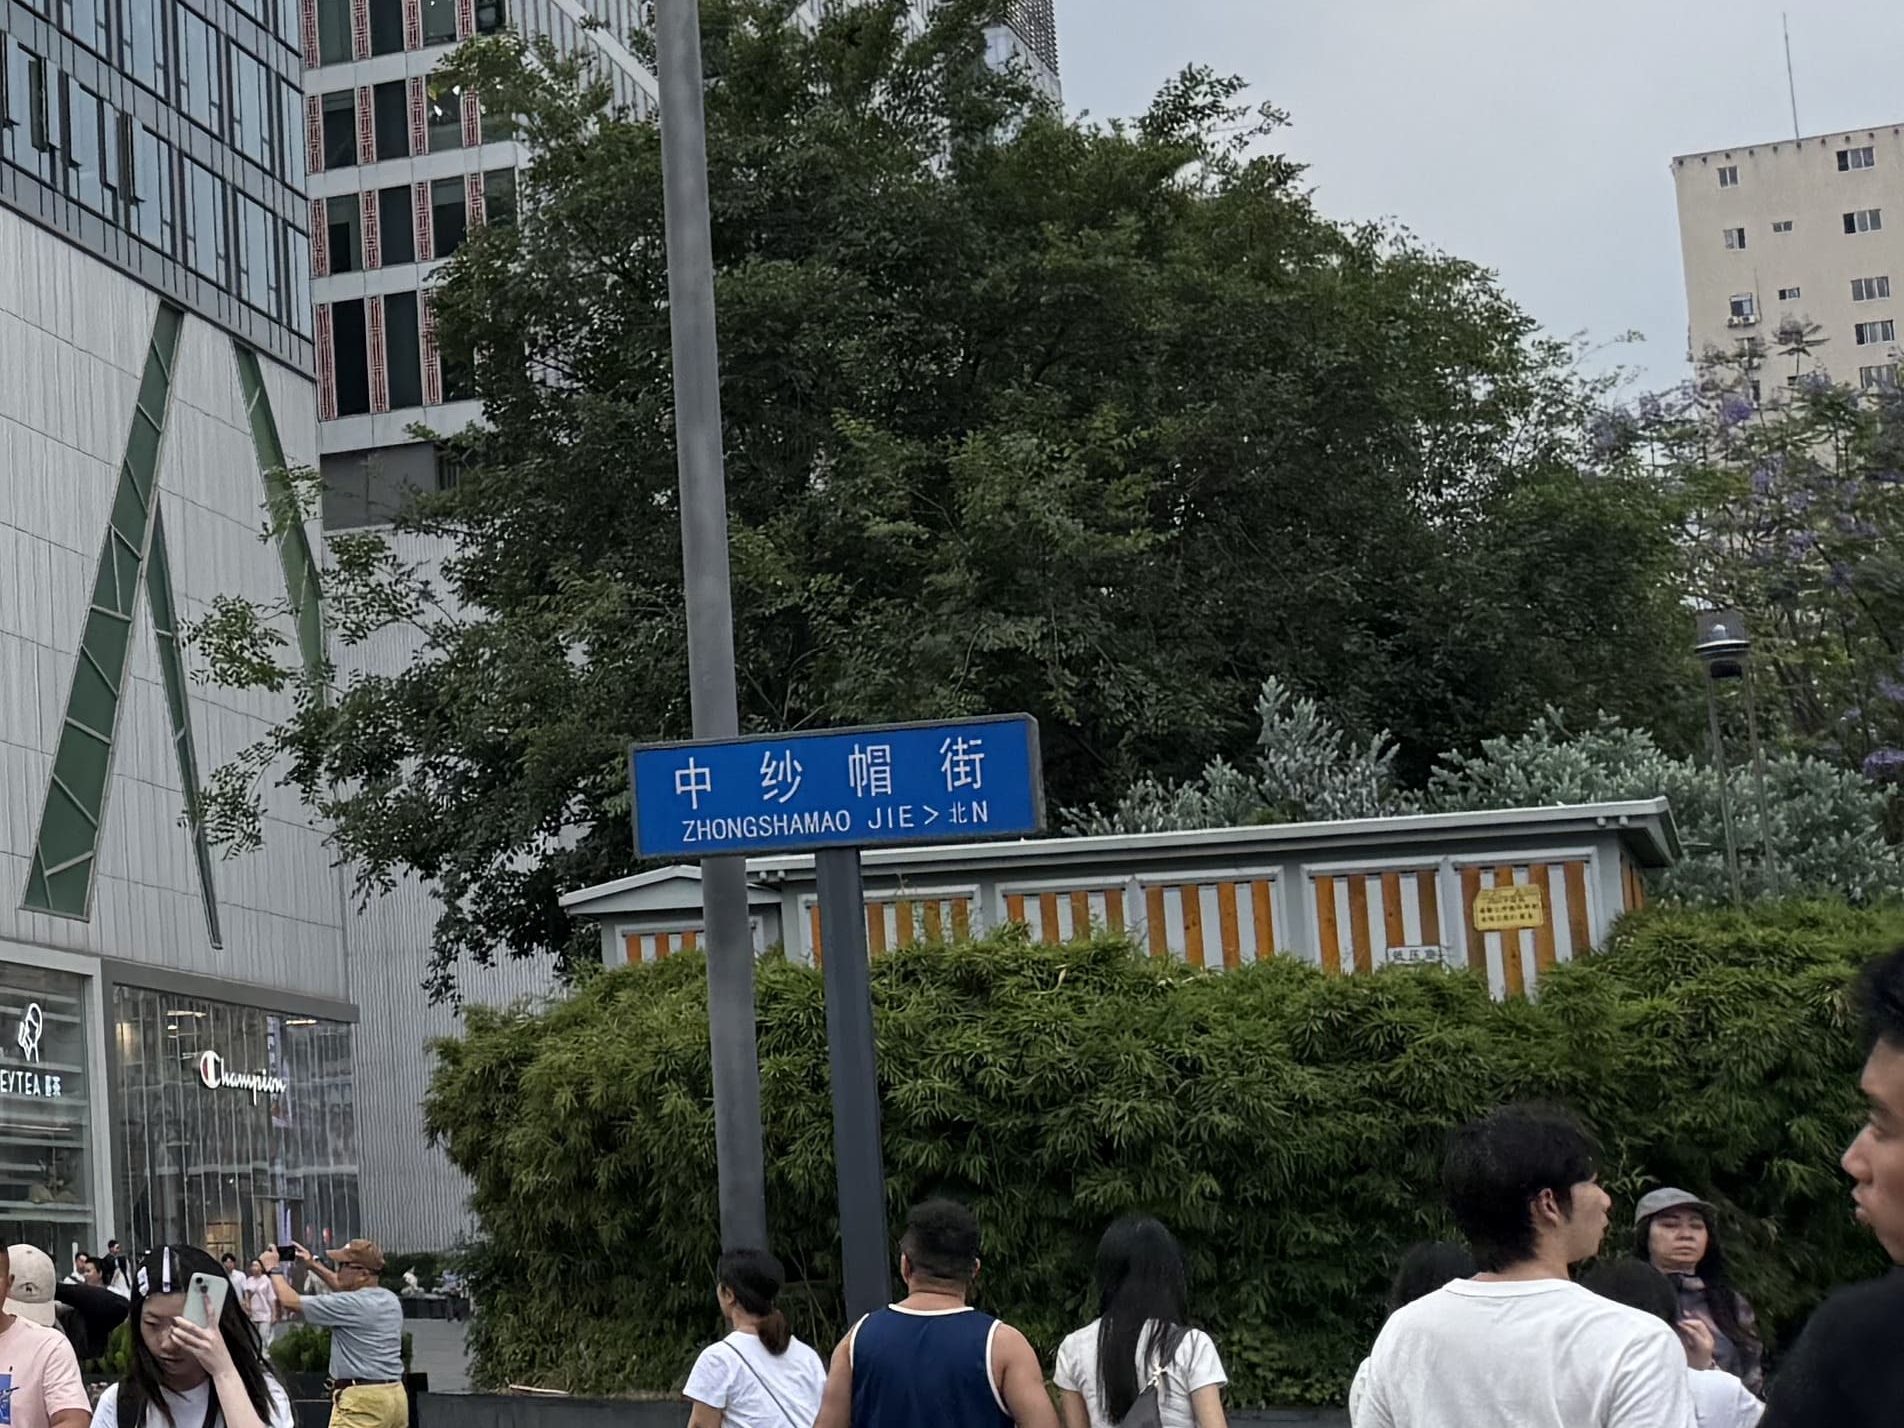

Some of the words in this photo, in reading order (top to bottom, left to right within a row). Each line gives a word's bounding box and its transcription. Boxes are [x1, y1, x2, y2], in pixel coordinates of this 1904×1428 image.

[674, 736, 985, 810] 中纱帽街
[682, 810, 851, 843] ZHONGSHAMAO
[868, 805, 915, 830] JIE
[199, 1049, 287, 1107] Champion
